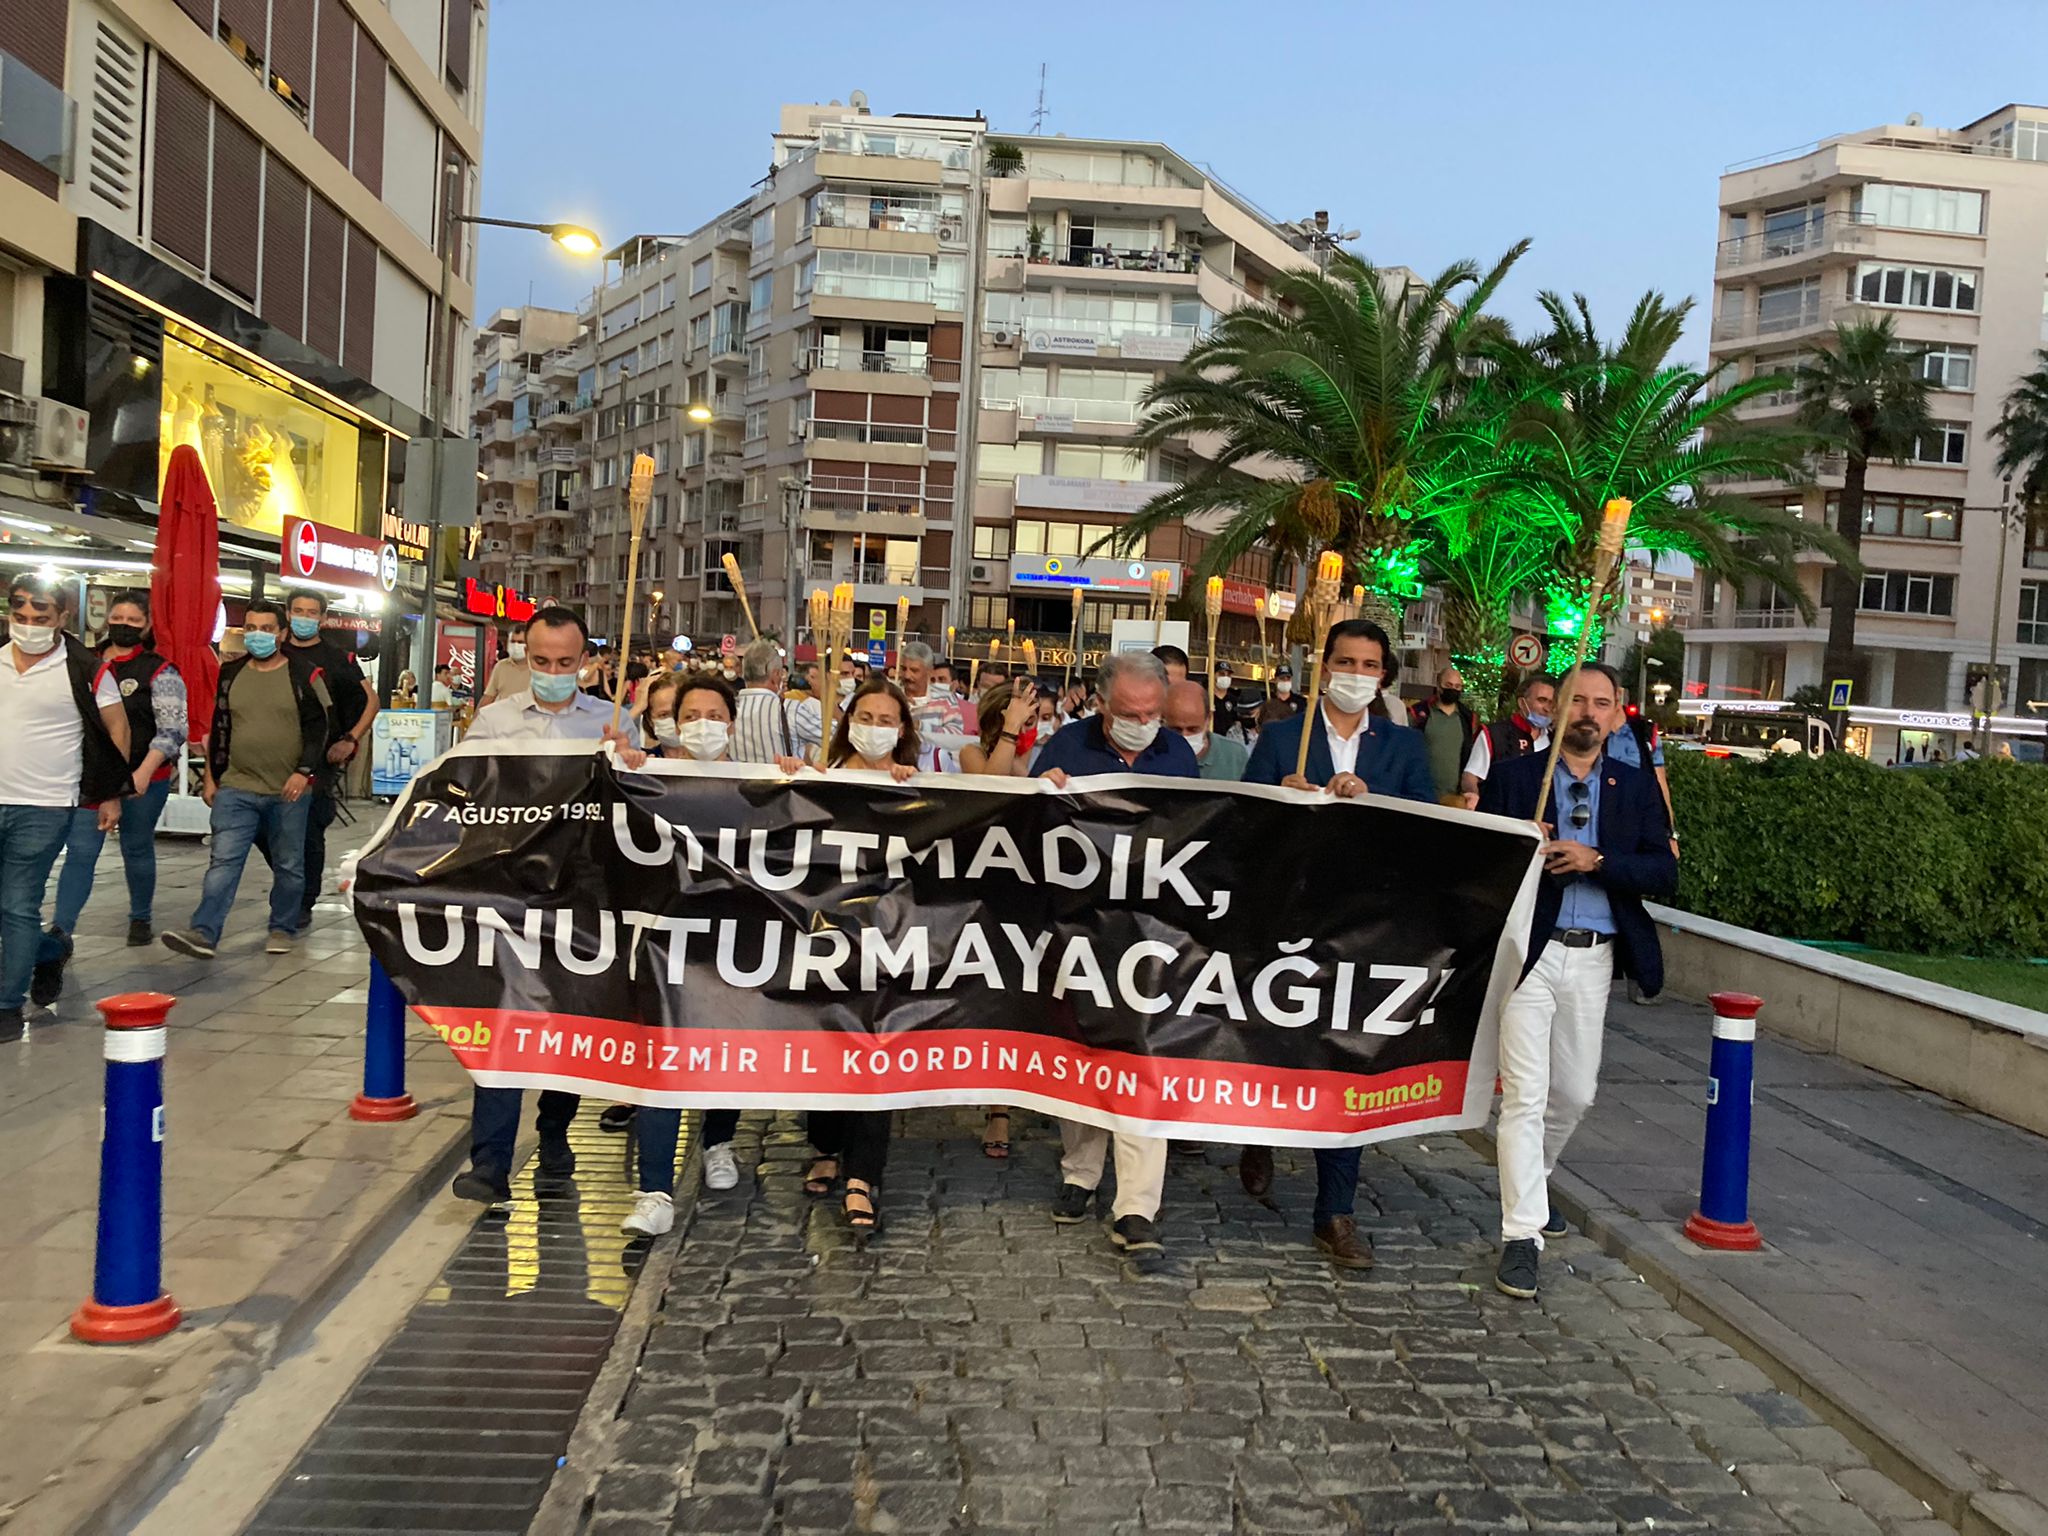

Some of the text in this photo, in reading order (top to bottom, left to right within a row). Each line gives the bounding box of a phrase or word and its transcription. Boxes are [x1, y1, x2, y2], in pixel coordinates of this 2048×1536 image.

[443, 802, 553, 825] AĞUSTOS
[514, 1027, 636, 1066] TMMOB
[646, 1038, 759, 1073] İZMİR
[783, 1042, 818, 1074] İL
[842, 1041, 1138, 1098] KOORDİNASYON
[1162, 1076, 1317, 1112] KURULU
[1343, 1073, 1442, 1111] tmmob
